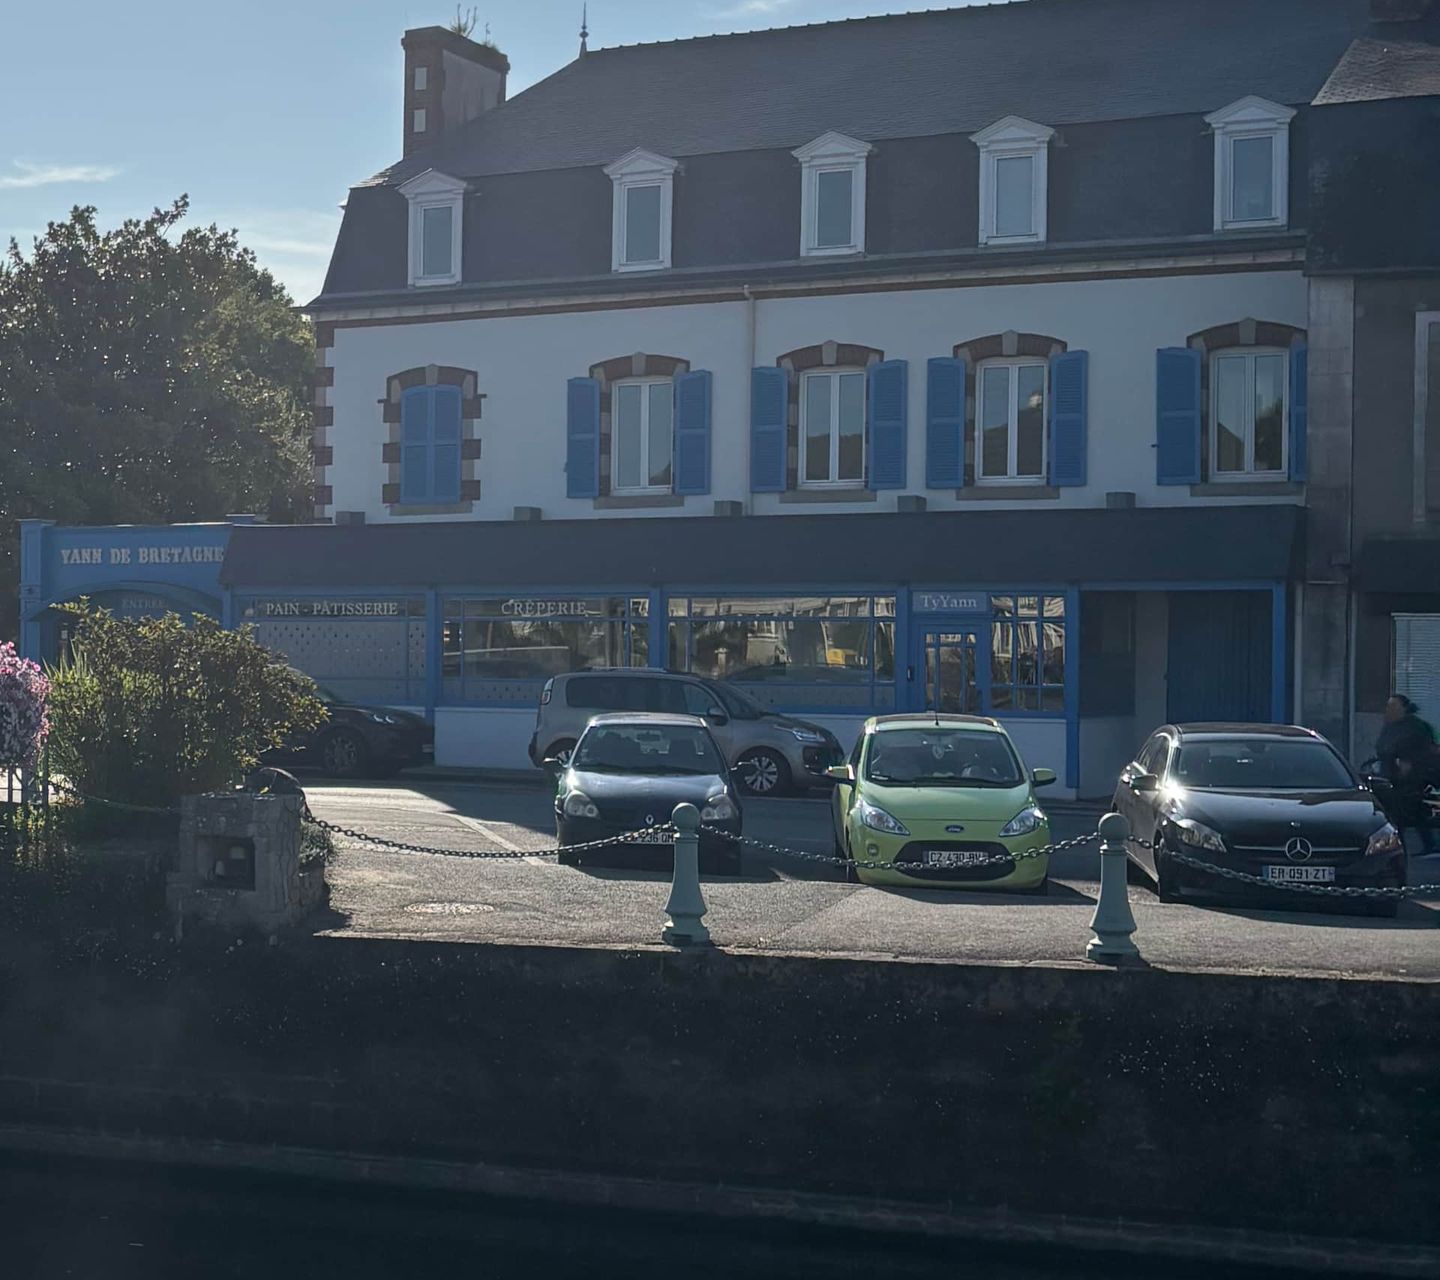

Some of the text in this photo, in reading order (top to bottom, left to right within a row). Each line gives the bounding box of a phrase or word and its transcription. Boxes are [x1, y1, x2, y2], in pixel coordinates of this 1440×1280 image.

[61, 546, 224, 564] YANN DE BRETAGNE
[266, 602, 299, 615] PAIN
[312, 600, 398, 615] PÂTISSERIE
[501, 599, 586, 616] CRÊPERIE
